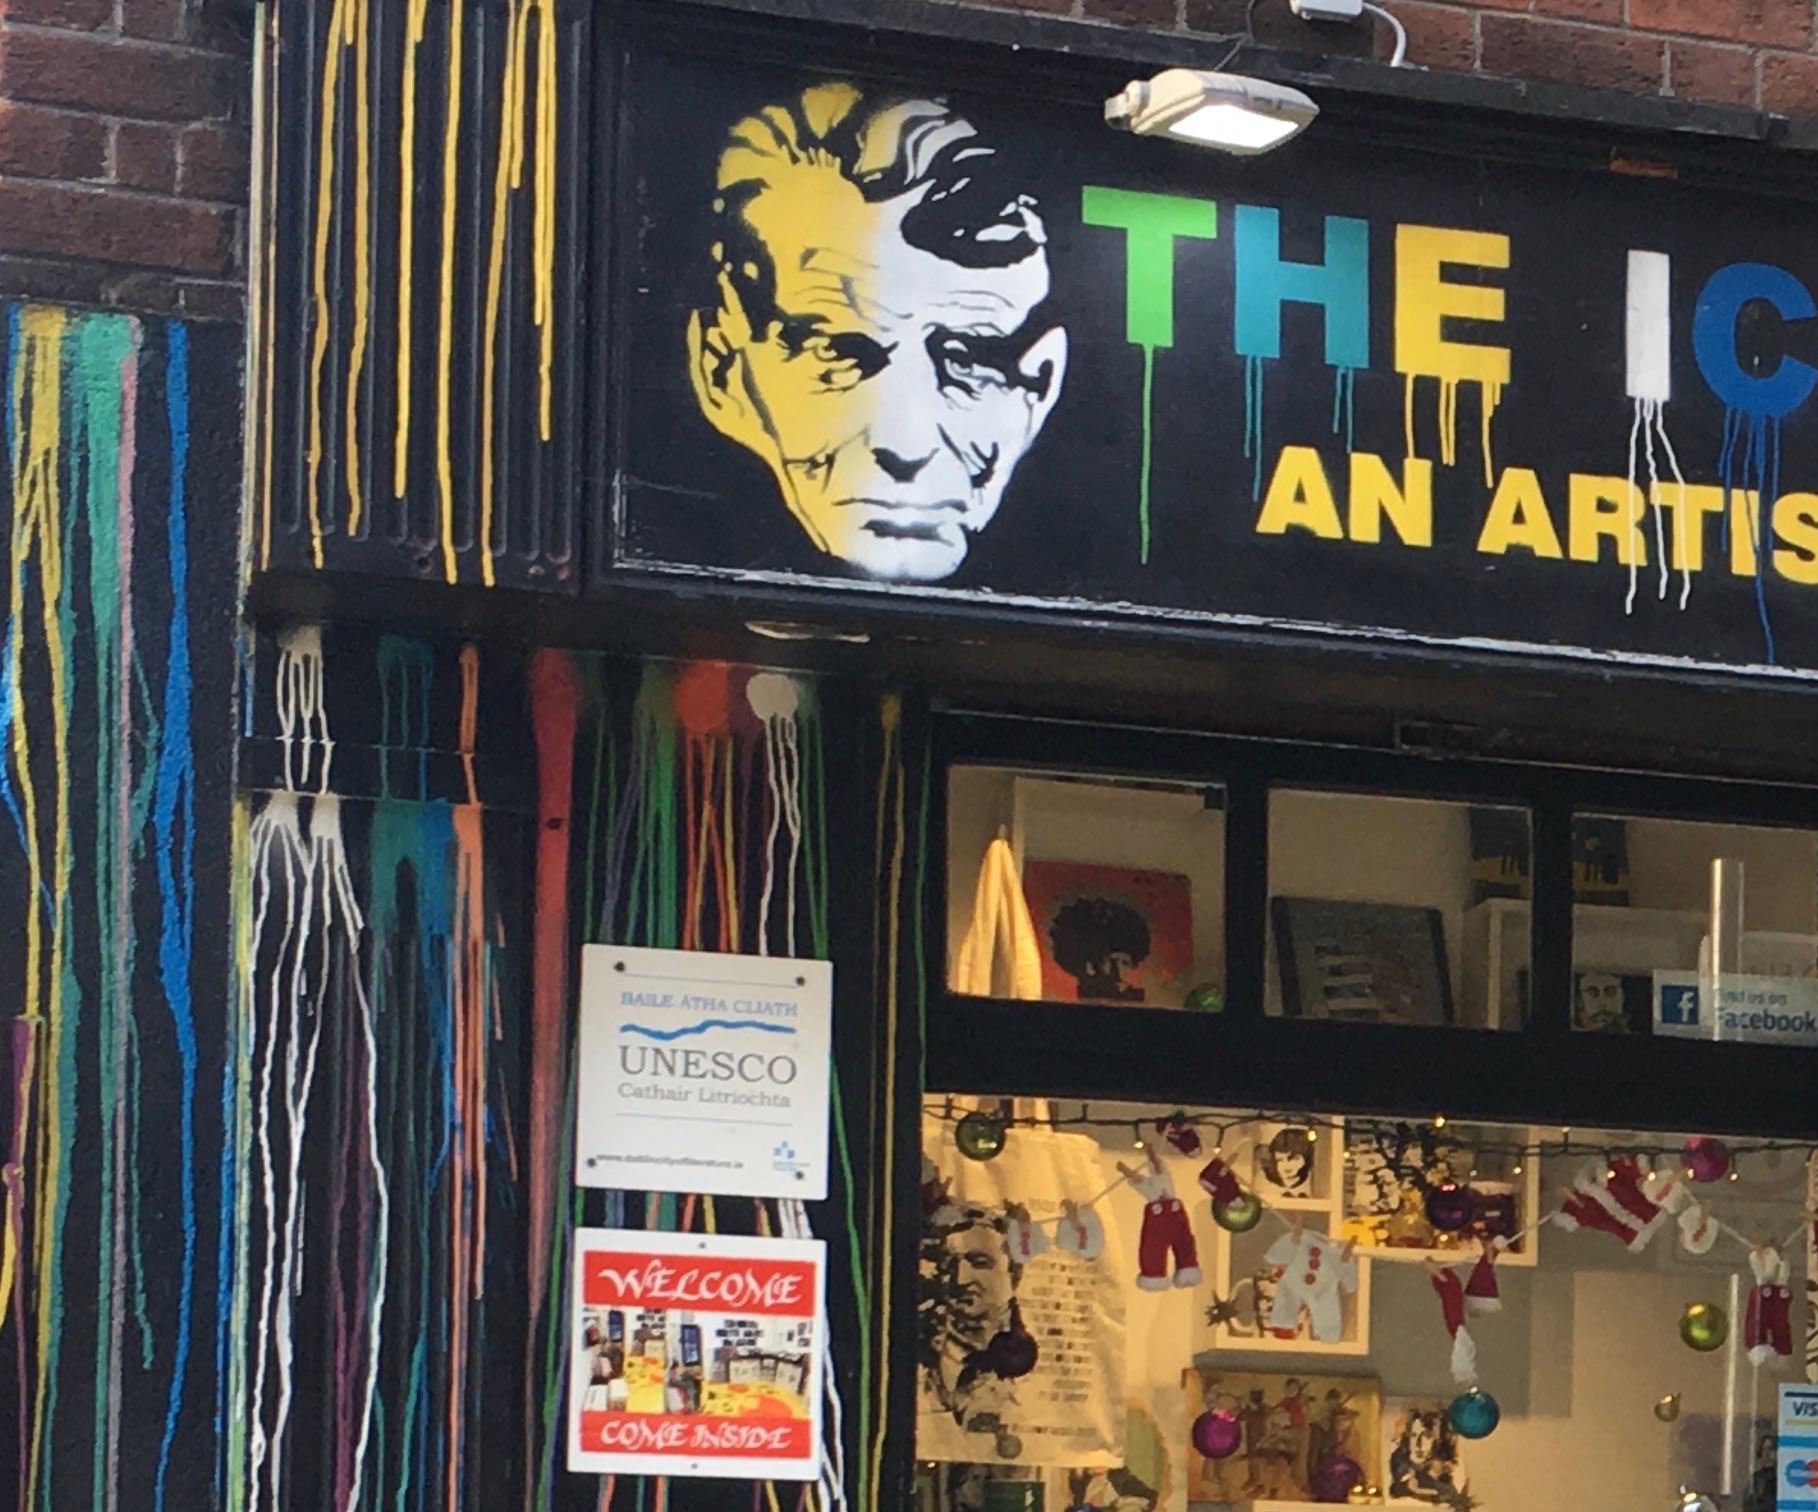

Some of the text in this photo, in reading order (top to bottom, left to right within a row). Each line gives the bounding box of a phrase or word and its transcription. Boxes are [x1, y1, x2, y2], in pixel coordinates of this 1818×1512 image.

[1082, 186, 1511, 384] THE
[1257, 446, 1432, 546] AN
[620, 991, 674, 1009] BAILE
[733, 999, 798, 1018] CLIATH
[619, 1045, 797, 1086] UNESCO
[618, 1082, 693, 1103] Cathair
[598, 1259, 803, 1307] WELCOME
[601, 1419, 793, 1451] COME INSIDE
